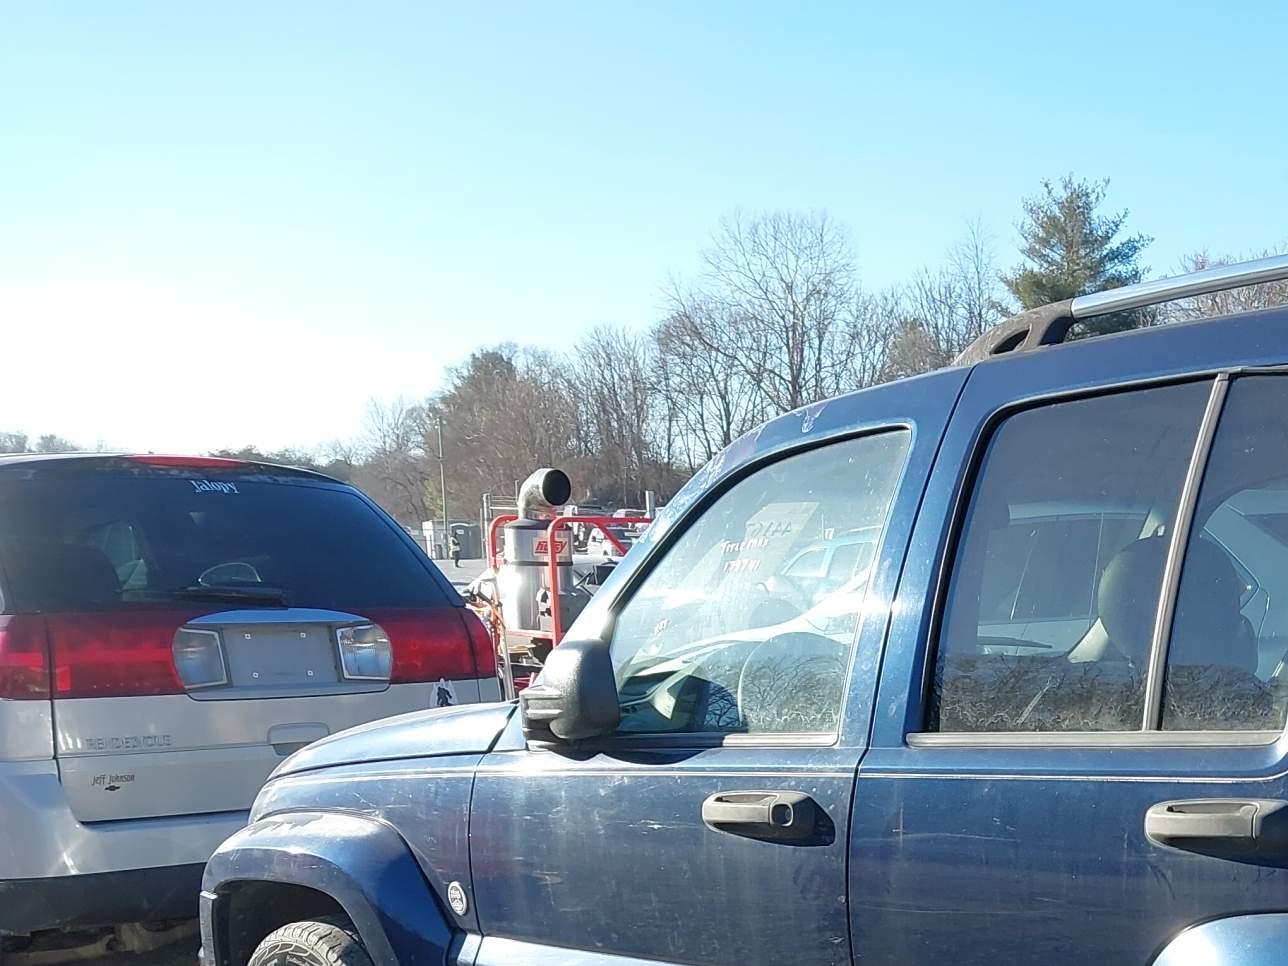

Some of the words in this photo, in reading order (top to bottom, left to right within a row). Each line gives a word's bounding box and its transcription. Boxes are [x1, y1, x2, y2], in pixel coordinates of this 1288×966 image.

[190, 479, 240, 494] Jalopy
[91, 774, 106, 786] Jeff
[108, 773, 136, 785] Johnson
